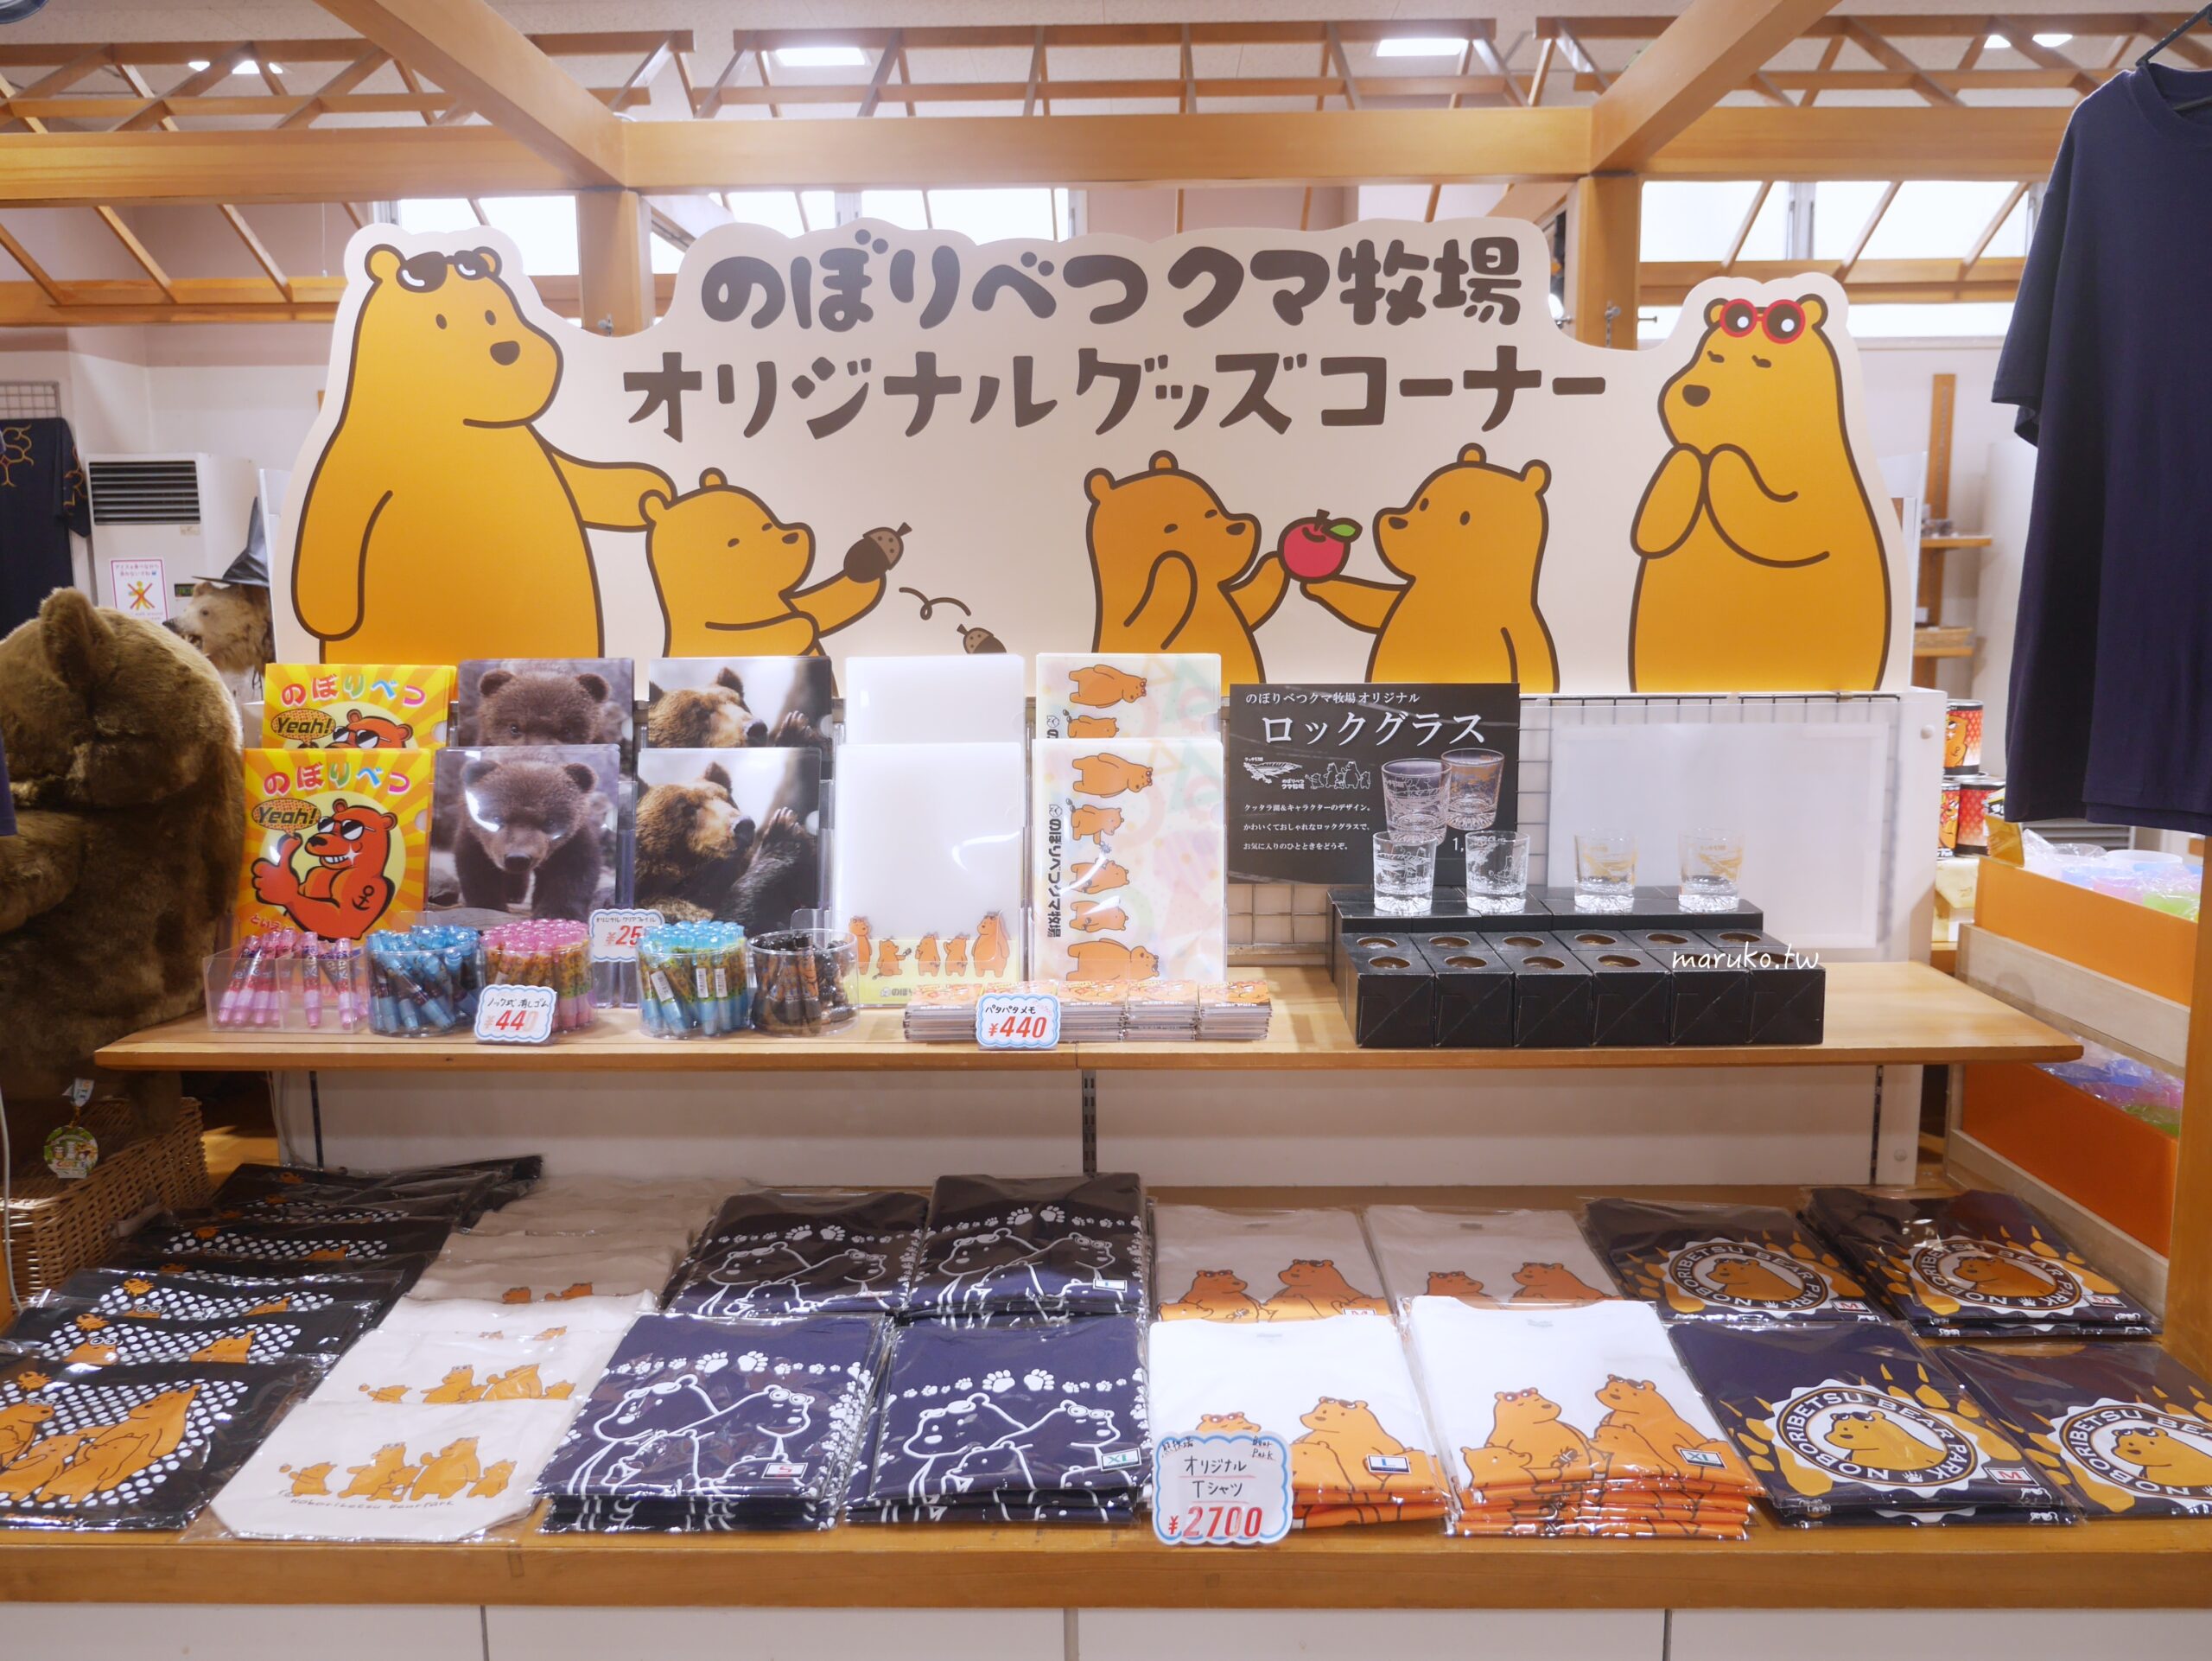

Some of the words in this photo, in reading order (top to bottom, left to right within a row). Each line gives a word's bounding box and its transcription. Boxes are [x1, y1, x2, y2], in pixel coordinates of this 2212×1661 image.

[701, 229, 1522, 332] のぼりべつクマ牧場
[622, 346, 1607, 443] オリジナルグッズコーナー
[281, 673, 426, 706] のぼりべつ
[1358, 692, 1421, 704] オリジナル
[277, 716, 333, 735] Yeah!
[1262, 710, 1485, 747] ロックグラス
[263, 761, 411, 796] のぼりべつ
[258, 806, 317, 821] Yeah!
[988, 1015, 1047, 1038] ¥440
[1677, 1245, 1752, 1307] NOBORIBETSU
[1755, 1251, 1814, 1280] BEAR
[1785, 1283, 1821, 1308] PARK
[2041, 1279, 2074, 1306] PARK
[1787, 1391, 1890, 1480] NOBORIBETSU
[1877, 1397, 1954, 1440] BEAR
[1926, 1443, 1967, 1480] PARK
[1184, 1455, 1247, 1476] オリジナル
[2069, 1410, 2191, 1496] NOBORIBETSU
[1192, 1480, 1243, 1499] Tシャツ
[1997, 1470, 2023, 1480] M
[1168, 1505, 1263, 1538] ¥2700
